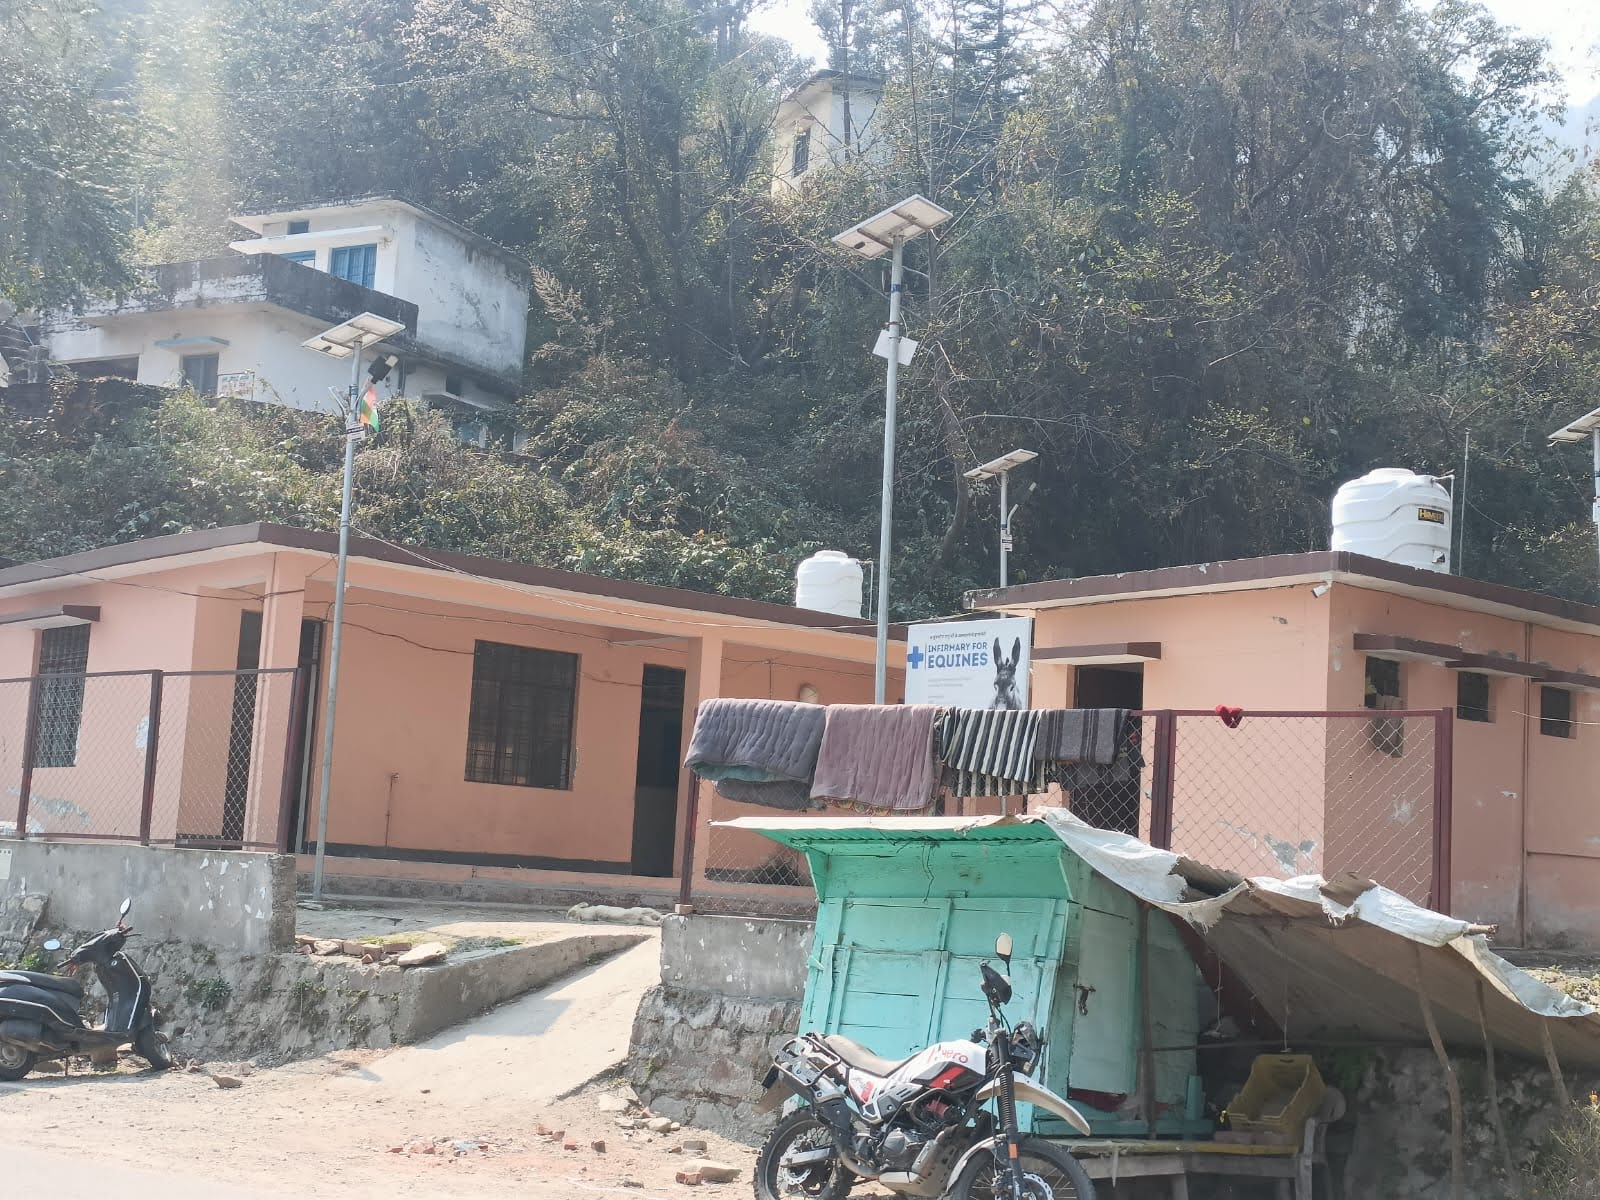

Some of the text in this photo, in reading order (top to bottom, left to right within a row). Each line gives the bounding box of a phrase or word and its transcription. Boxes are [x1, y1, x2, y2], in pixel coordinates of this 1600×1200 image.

[928, 641, 988, 653] INFIRMARY FOR
[928, 652, 988, 669] EQUINES
